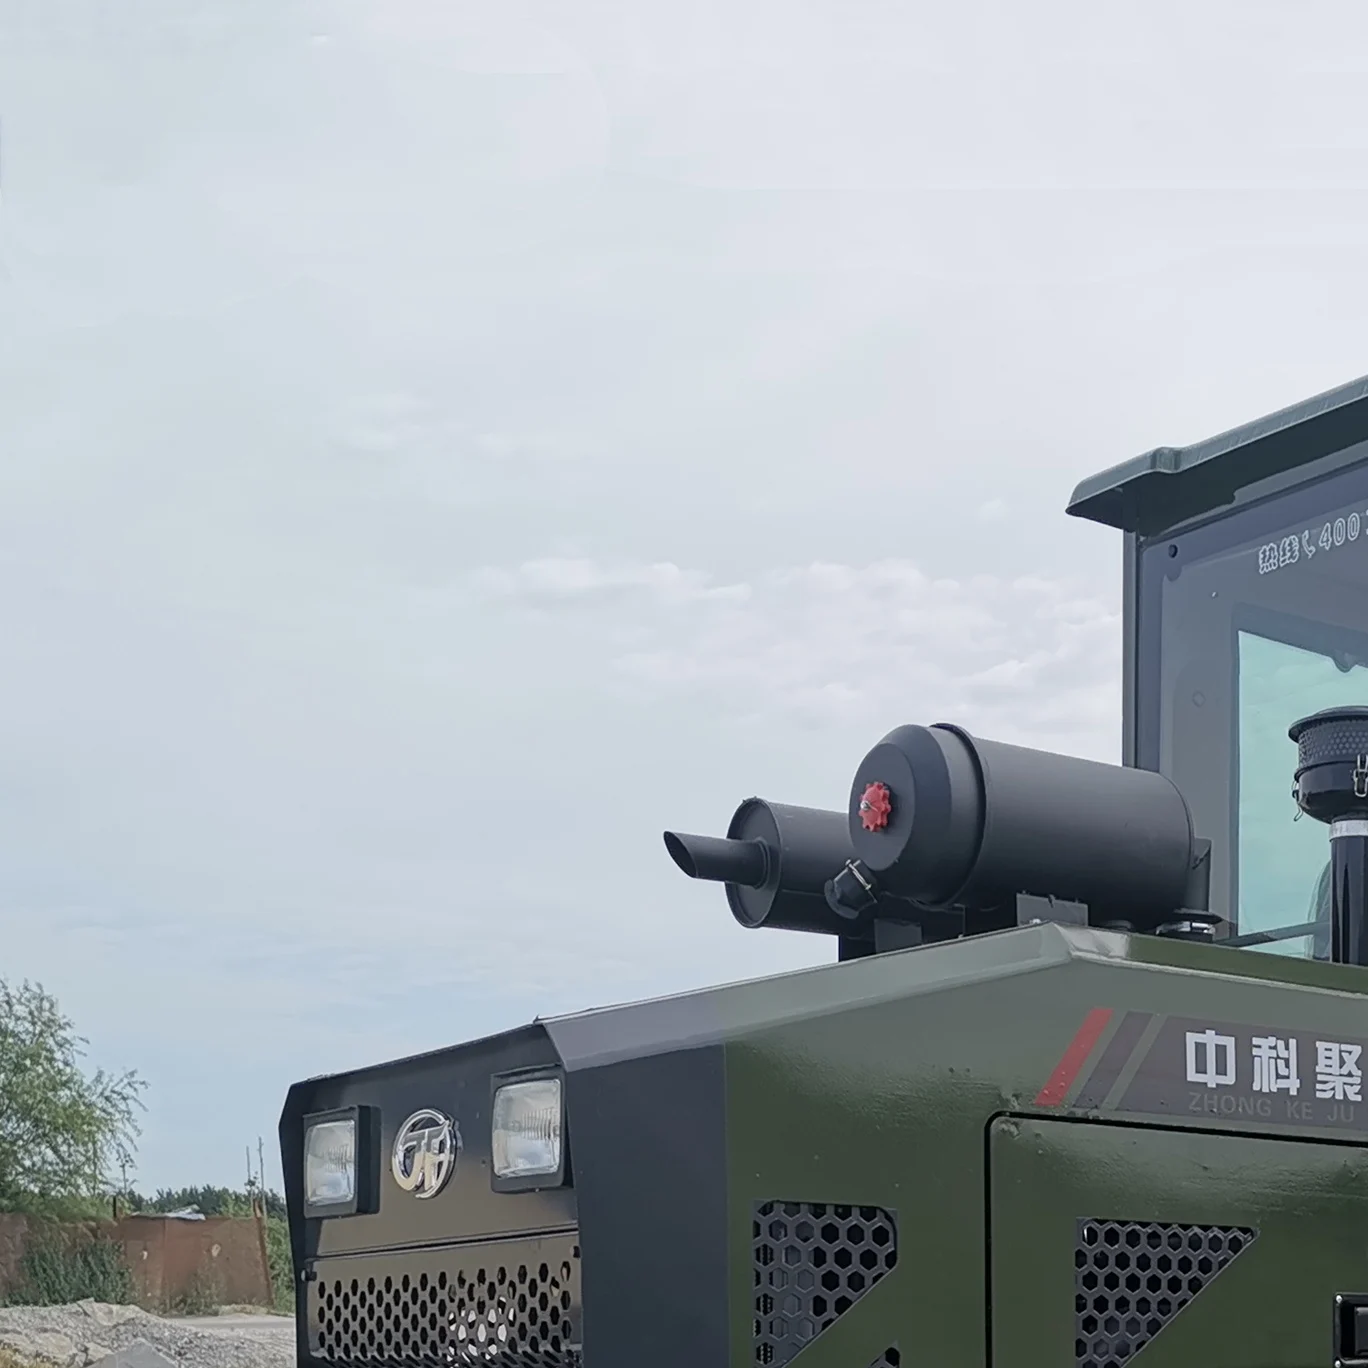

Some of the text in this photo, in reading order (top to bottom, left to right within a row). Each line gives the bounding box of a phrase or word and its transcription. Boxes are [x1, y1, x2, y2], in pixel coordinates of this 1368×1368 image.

[1258, 535, 1300, 574] 热线
[1318, 512, 1360, 551] 400
[1188, 1091, 1272, 1118] ZHONG
[1286, 1099, 1314, 1121] KE
[1327, 1103, 1355, 1124] JU
